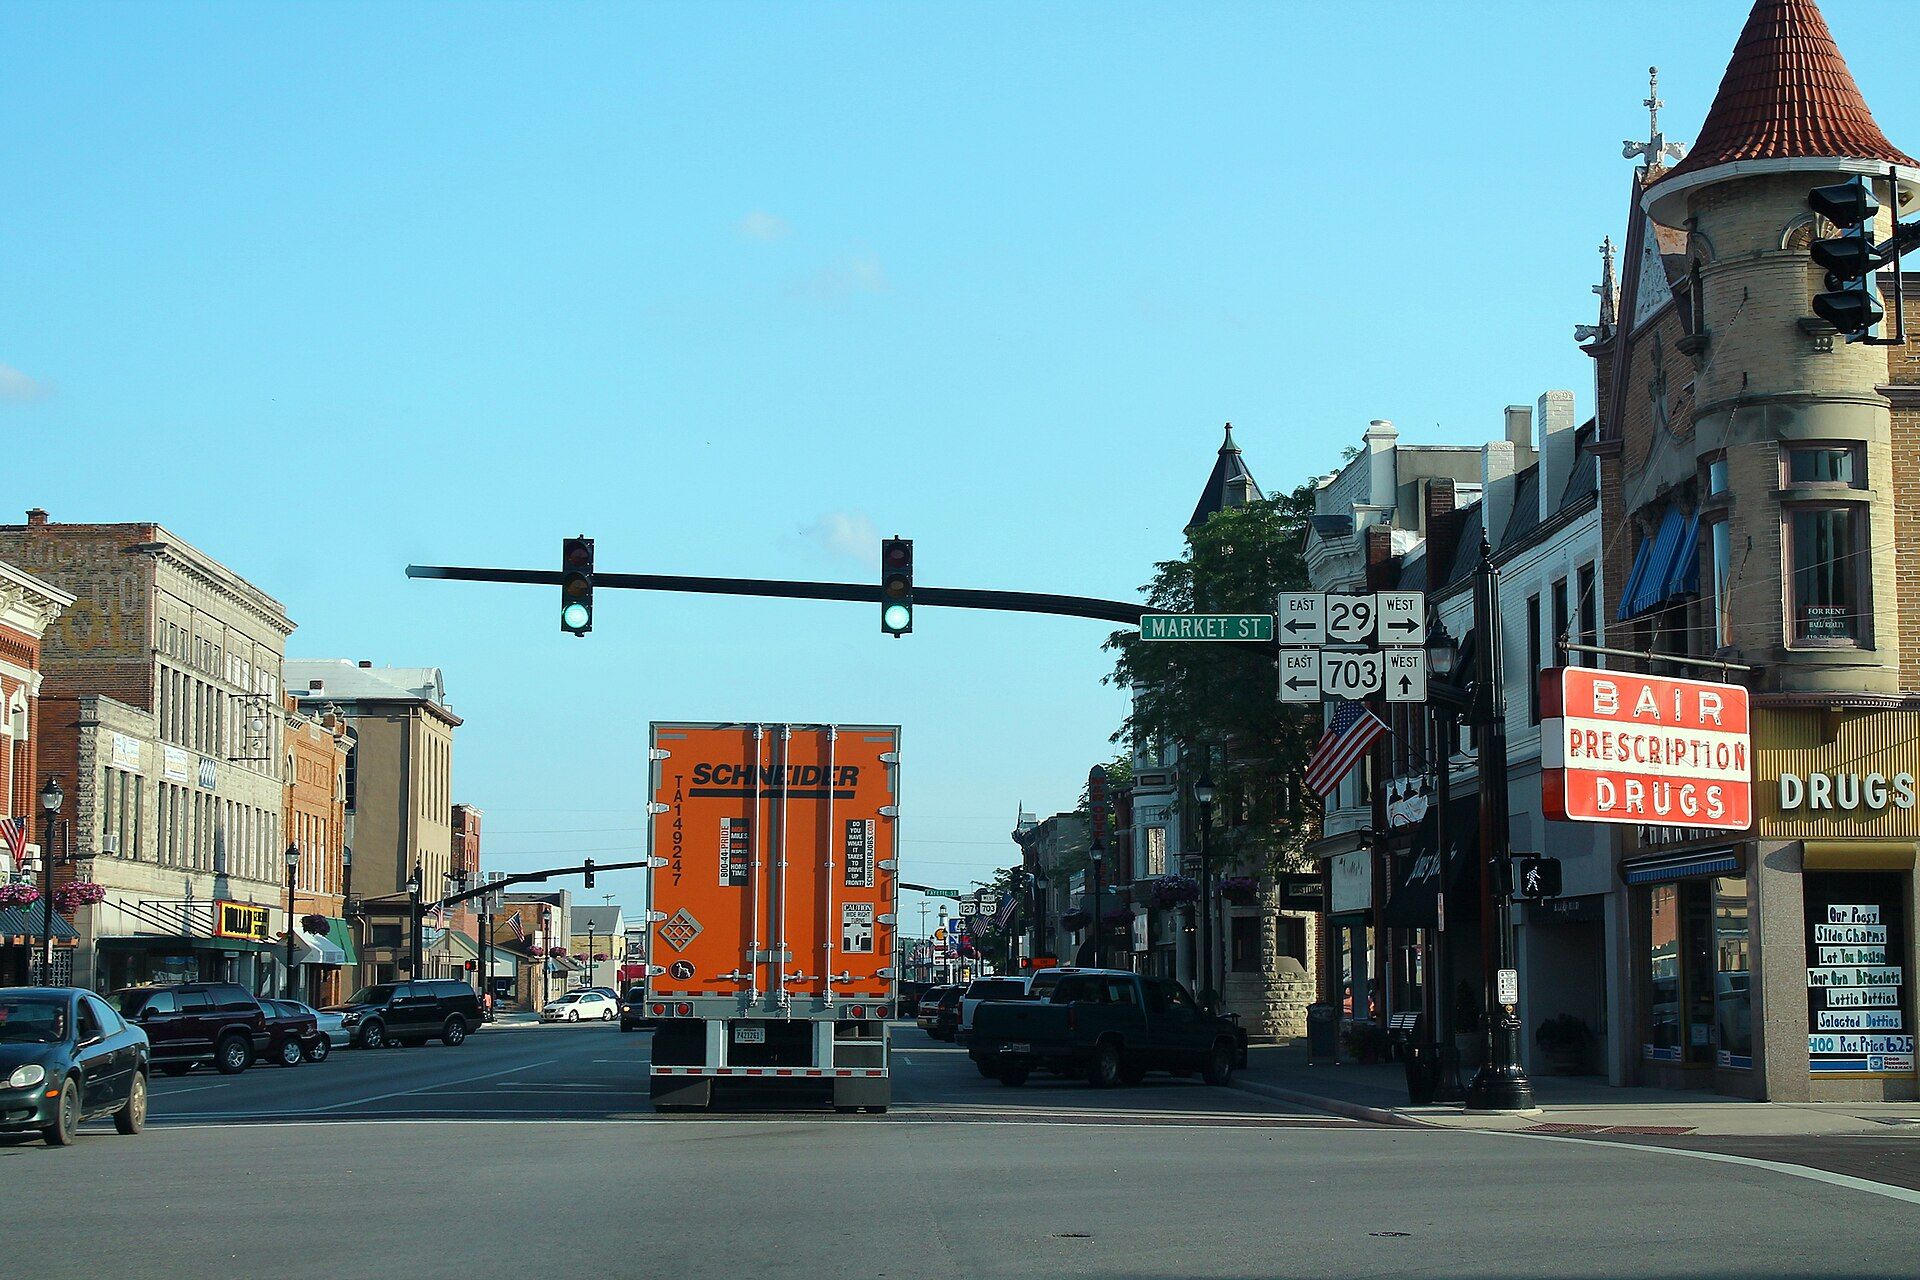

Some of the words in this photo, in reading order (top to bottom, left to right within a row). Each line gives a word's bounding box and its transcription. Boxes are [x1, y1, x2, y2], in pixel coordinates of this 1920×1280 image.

[1290, 599, 1315, 610] EAST
[1386, 599, 1414, 610] WEST
[1331, 602, 1371, 630] 29
[1152, 618, 1228, 637] MARKET
[1239, 618, 1261, 637] ST
[1287, 657, 1312, 668] EAST
[1391, 656, 1418, 667] WEST
[1328, 660, 1377, 688] 703
[1593, 680, 1724, 726] BAIR
[1570, 728, 1746, 771] PRESCRIPTION
[691, 763, 859, 786] SCHNEIDER
[1596, 777, 1726, 819] DRUGS
[1781, 772, 1916, 809] DRUGS
[672, 776, 683, 886] TA149247
[961, 905, 975, 913] 127
[1830, 906, 1847, 922] Our
[1817, 926, 1842, 942] Slide
[1845, 928, 1885, 943] Charms
[1840, 948, 1854, 963] You
[1808, 970, 1828, 985] Your
[1831, 970, 1848, 985] Own
[1856, 969, 1900, 985] Bracelets
[1820, 1012, 1860, 1028] Selected
[1860, 1036, 1884, 1052] Price
